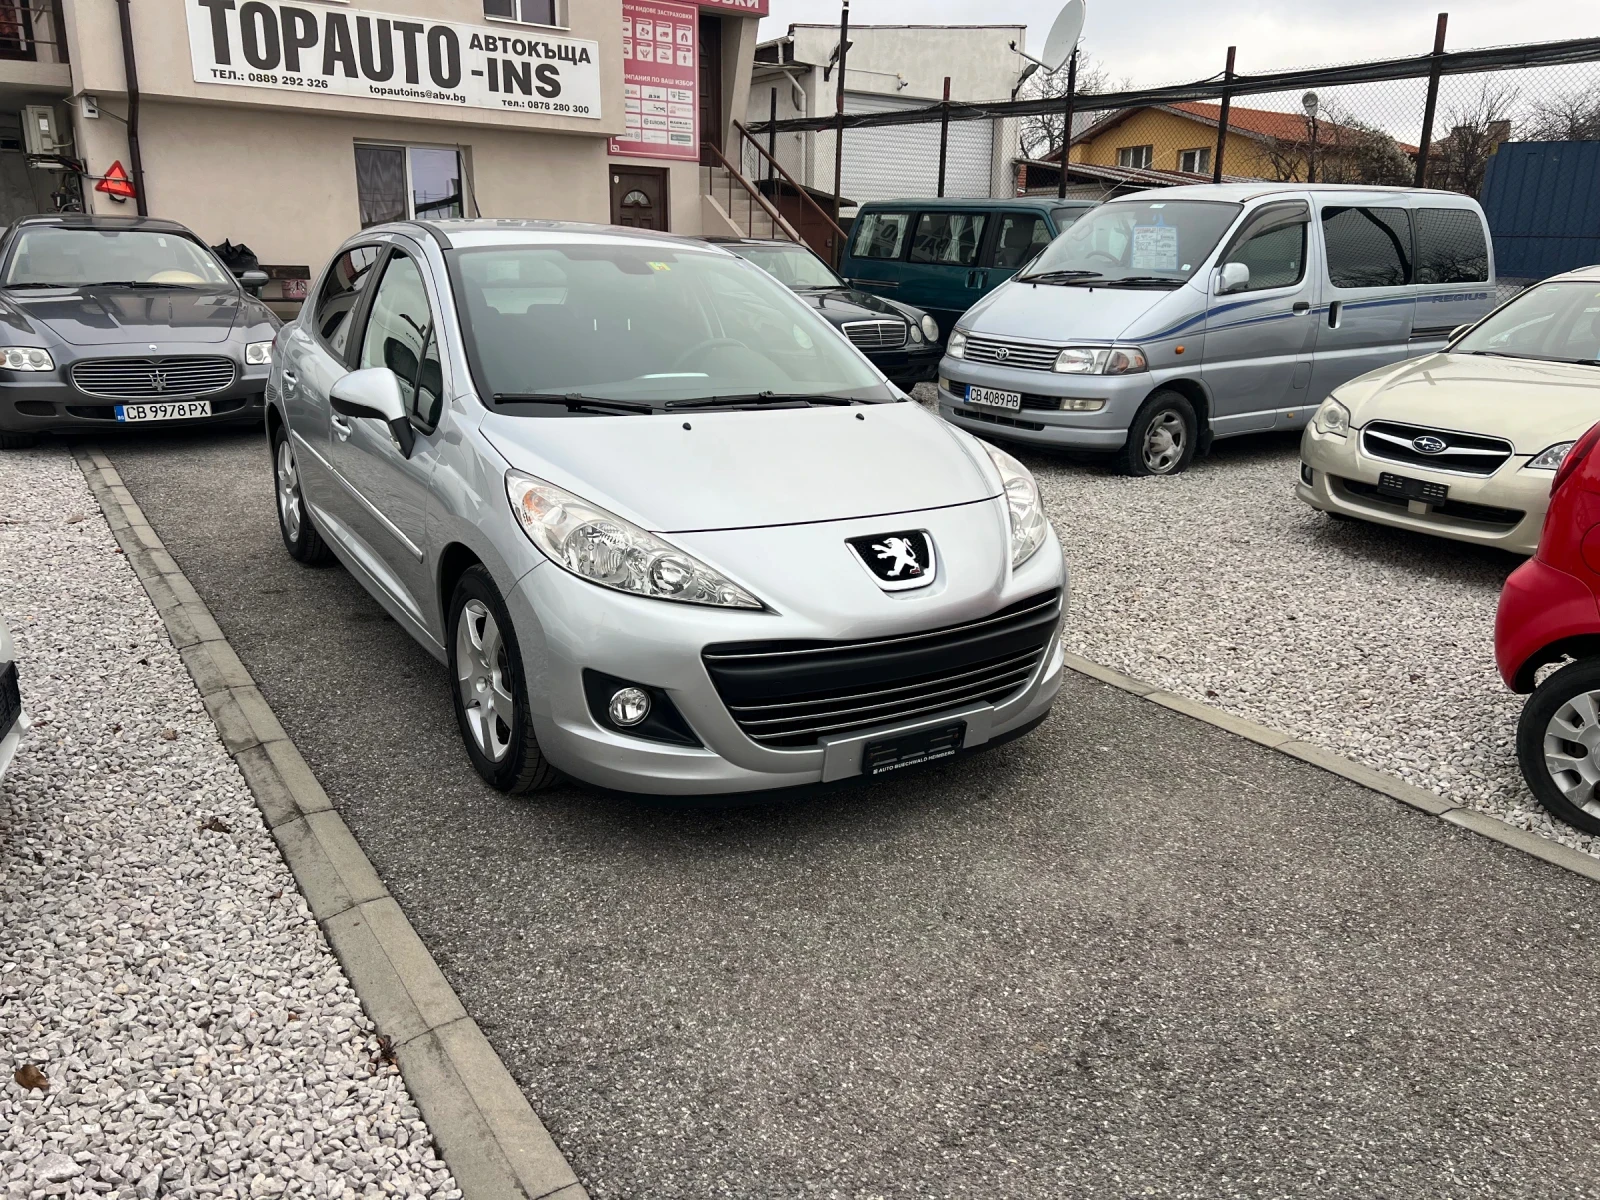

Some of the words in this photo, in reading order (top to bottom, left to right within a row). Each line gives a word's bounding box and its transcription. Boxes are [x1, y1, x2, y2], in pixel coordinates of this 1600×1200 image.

[635, 5, 656, 14] ВИДОВЕ
[657, 9, 692, 20] ЗАСТРАХОВКИ
[199, 0, 461, 89] TOPAUTO
[469, 33, 591, 65] АВТОКЪЩА
[211, 68, 244, 81] ТЕЛ.:
[248, 72, 278, 84] 0889
[281, 76, 304, 86] 292
[307, 78, 328, 89] 326
[675, 79, 694, 87] ИЗБОР
[369, 85, 466, 103] topautoins@abv.bg
[501, 99, 525, 108] тел.:
[528, 100, 550, 111] 0878
[553, 102, 570, 113] 280
[572, 104, 589, 114] 300
[1431, 292, 1488, 304] REGIUS
[970, 388, 982, 402] CB
[983, 390, 1005, 406] 4089
[1006, 394, 1019, 408] PB
[126, 405, 147, 420] CB
[149, 404, 186, 418] 9978
[188, 402, 208, 416] PX
[878, 765, 894, 773] AUTO
